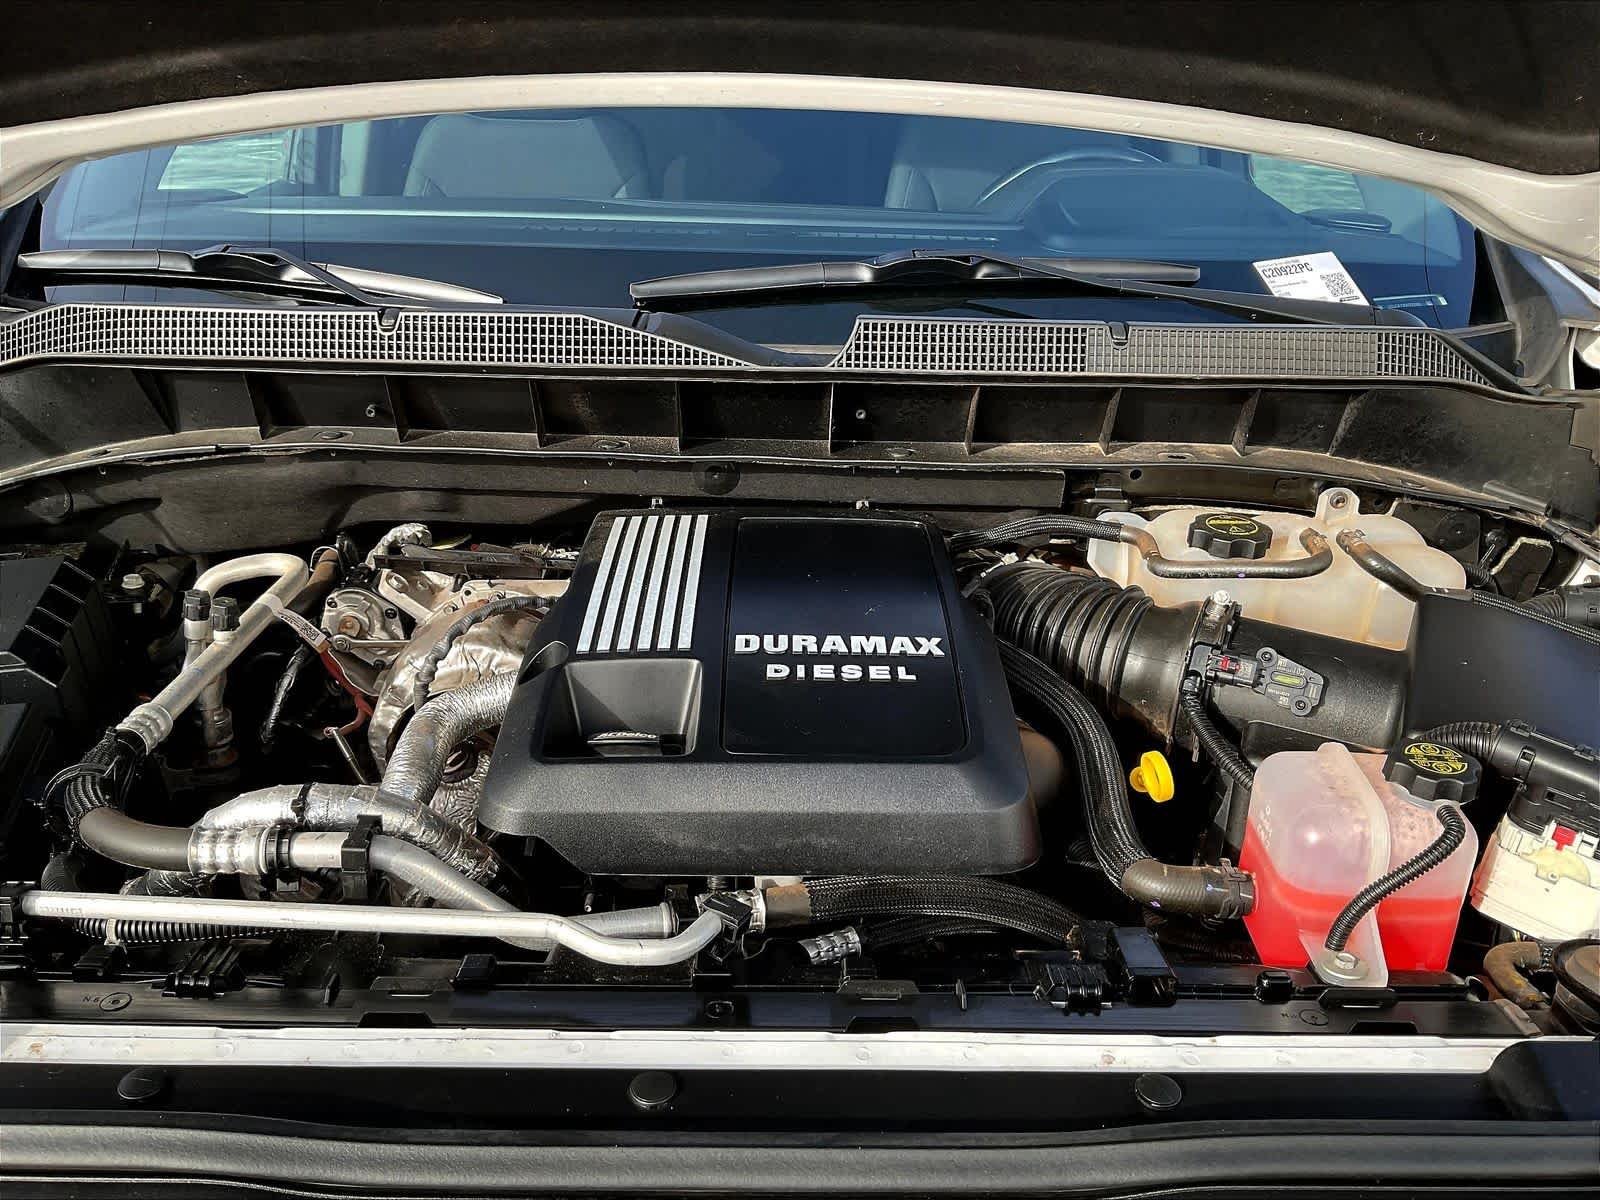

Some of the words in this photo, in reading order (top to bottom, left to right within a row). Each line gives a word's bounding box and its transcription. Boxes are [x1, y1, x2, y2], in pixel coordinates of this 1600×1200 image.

[1261, 262, 1313, 279] C20922PC
[735, 634, 945, 657] DURAMAX
[766, 664, 917, 681] DIESEL
